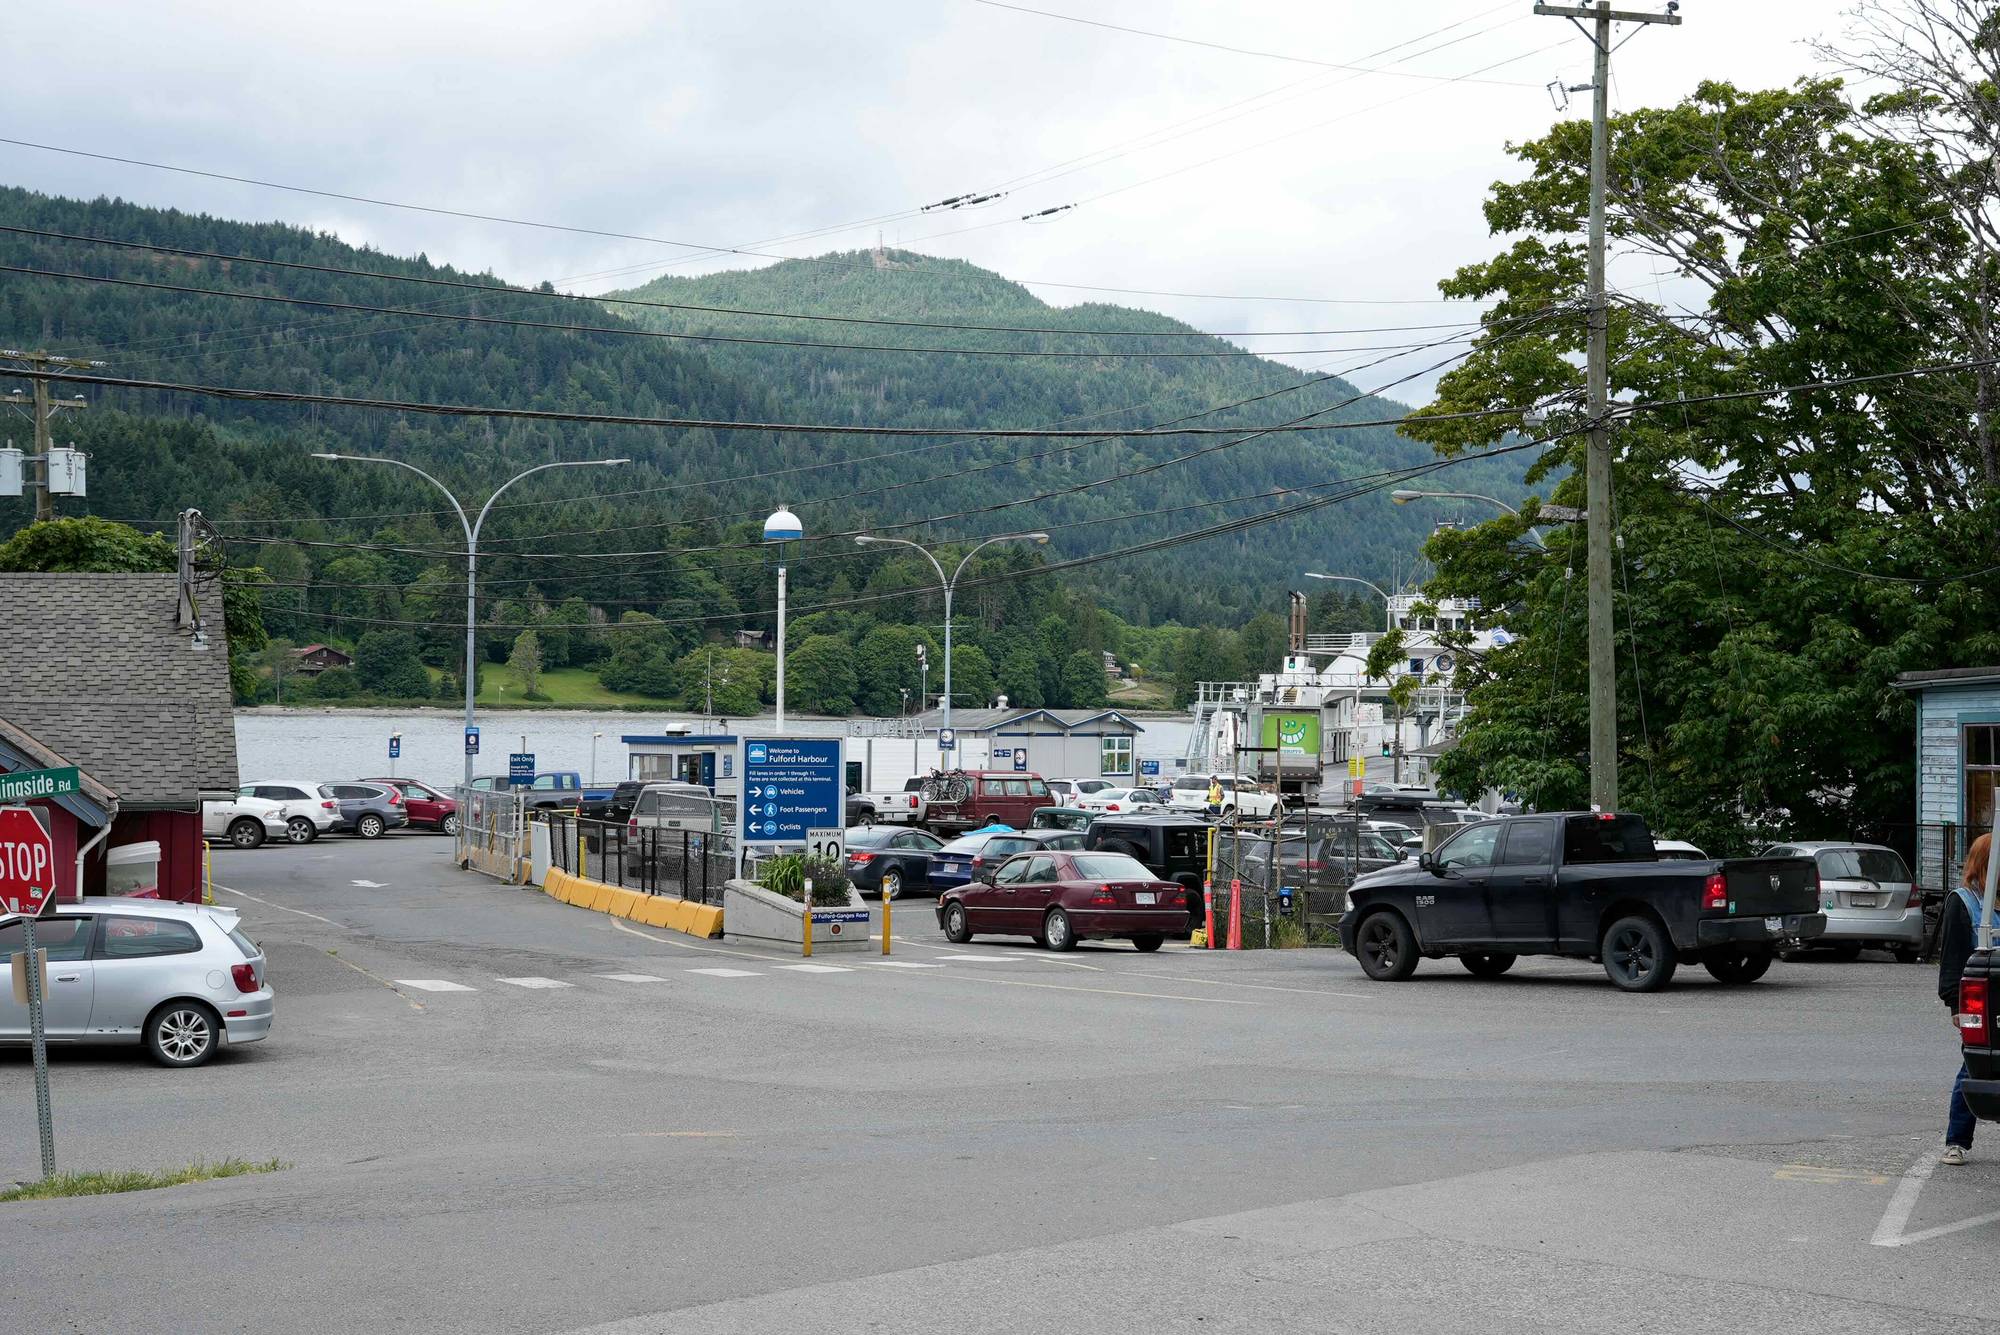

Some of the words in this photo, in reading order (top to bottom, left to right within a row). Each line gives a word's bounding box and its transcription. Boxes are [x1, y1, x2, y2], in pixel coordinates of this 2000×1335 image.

[0, 774, 54, 798] ingside
[58, 780, 71, 791] Rd
[813, 841, 840, 863] 10
